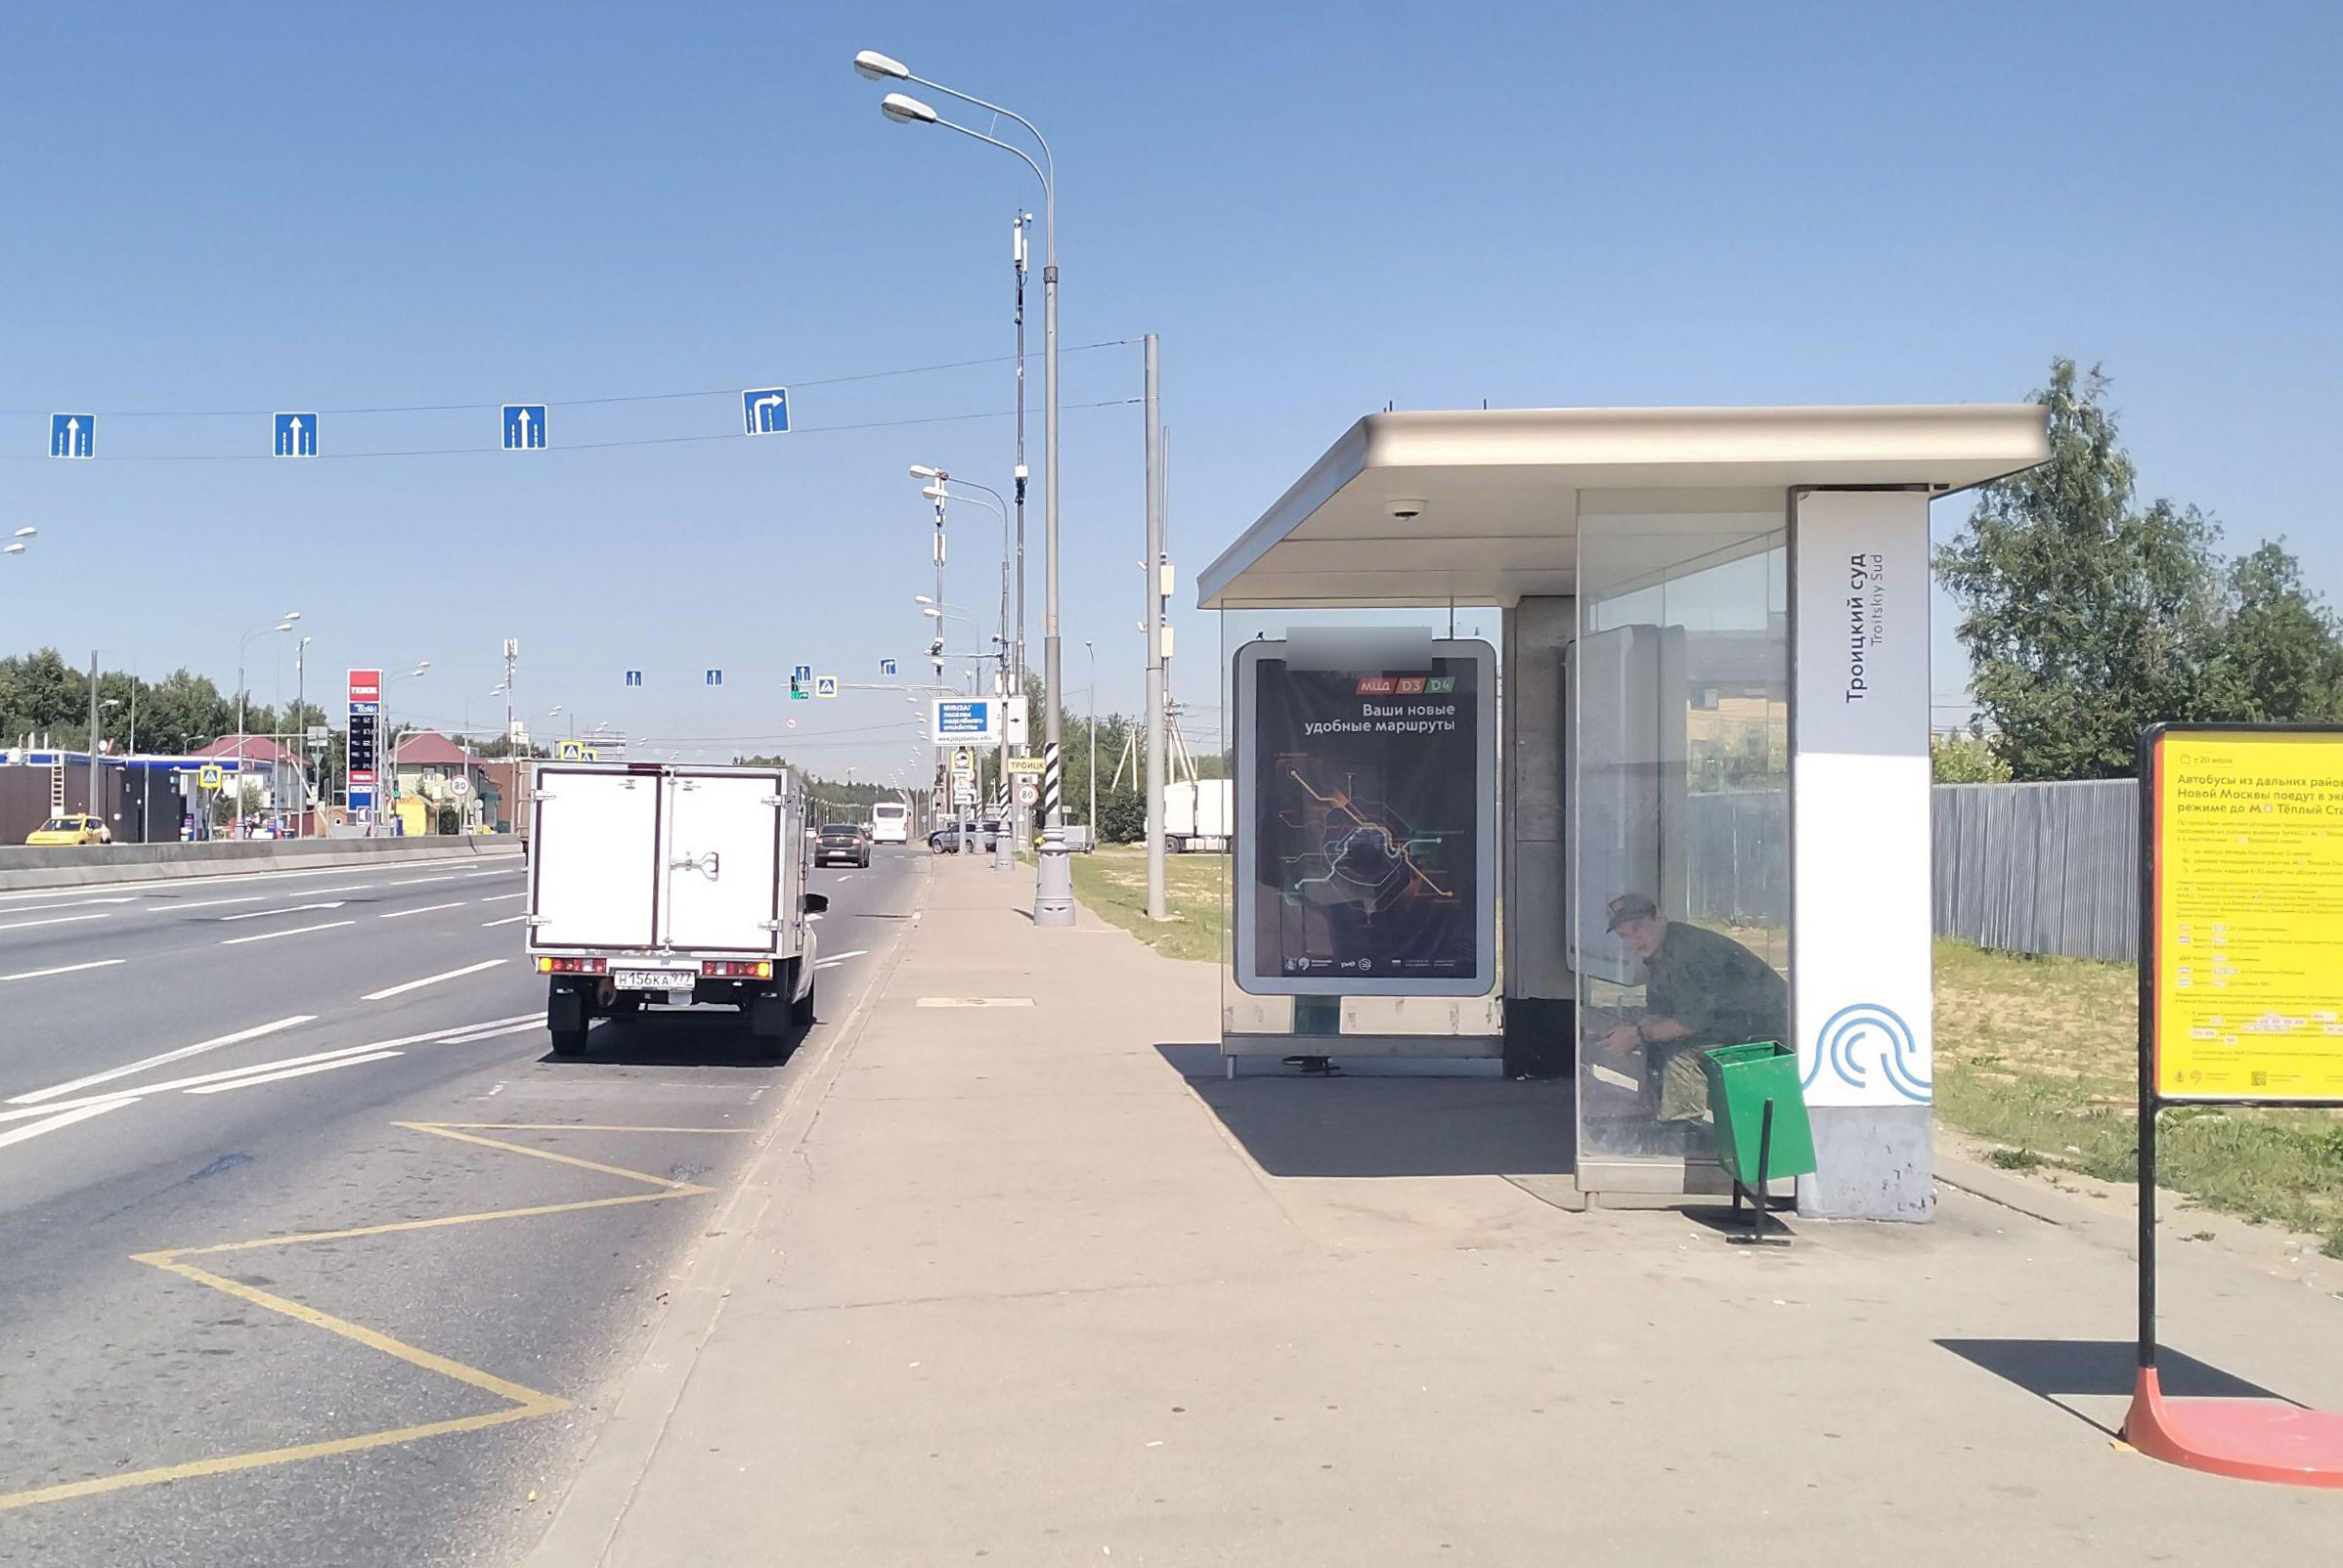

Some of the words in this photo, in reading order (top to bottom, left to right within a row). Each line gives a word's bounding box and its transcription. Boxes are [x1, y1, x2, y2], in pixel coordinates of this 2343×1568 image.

[1851, 554, 1867, 589] суд
[1870, 554, 1883, 581] Sud
[1870, 585, 1885, 646] Troitskiy
[1846, 597, 1867, 703] Троицкий
[1361, 679, 1390, 691] МЦД
[1402, 681, 1420, 691] D3
[1431, 680, 1450, 690] D4
[1363, 704, 1403, 717] Ваши
[1408, 705, 1455, 716] новые
[1305, 719, 1371, 735] удобные
[1375, 719, 1455, 734] маршруты
[454, 781, 466, 790] 80
[2177, 773, 2236, 788] Автобусы
[2239, 776, 2253, 785] из
[2255, 776, 2307, 787] дальних
[1021, 790, 1033, 799] 80
[2177, 787, 2217, 799] Новой
[2219, 788, 2271, 800] Москвы
[2274, 791, 2315, 803] поедут
[2177, 804, 2228, 814] режиме
[2230, 805, 2245, 814] до
[2277, 803, 2322, 815] Тёплый
